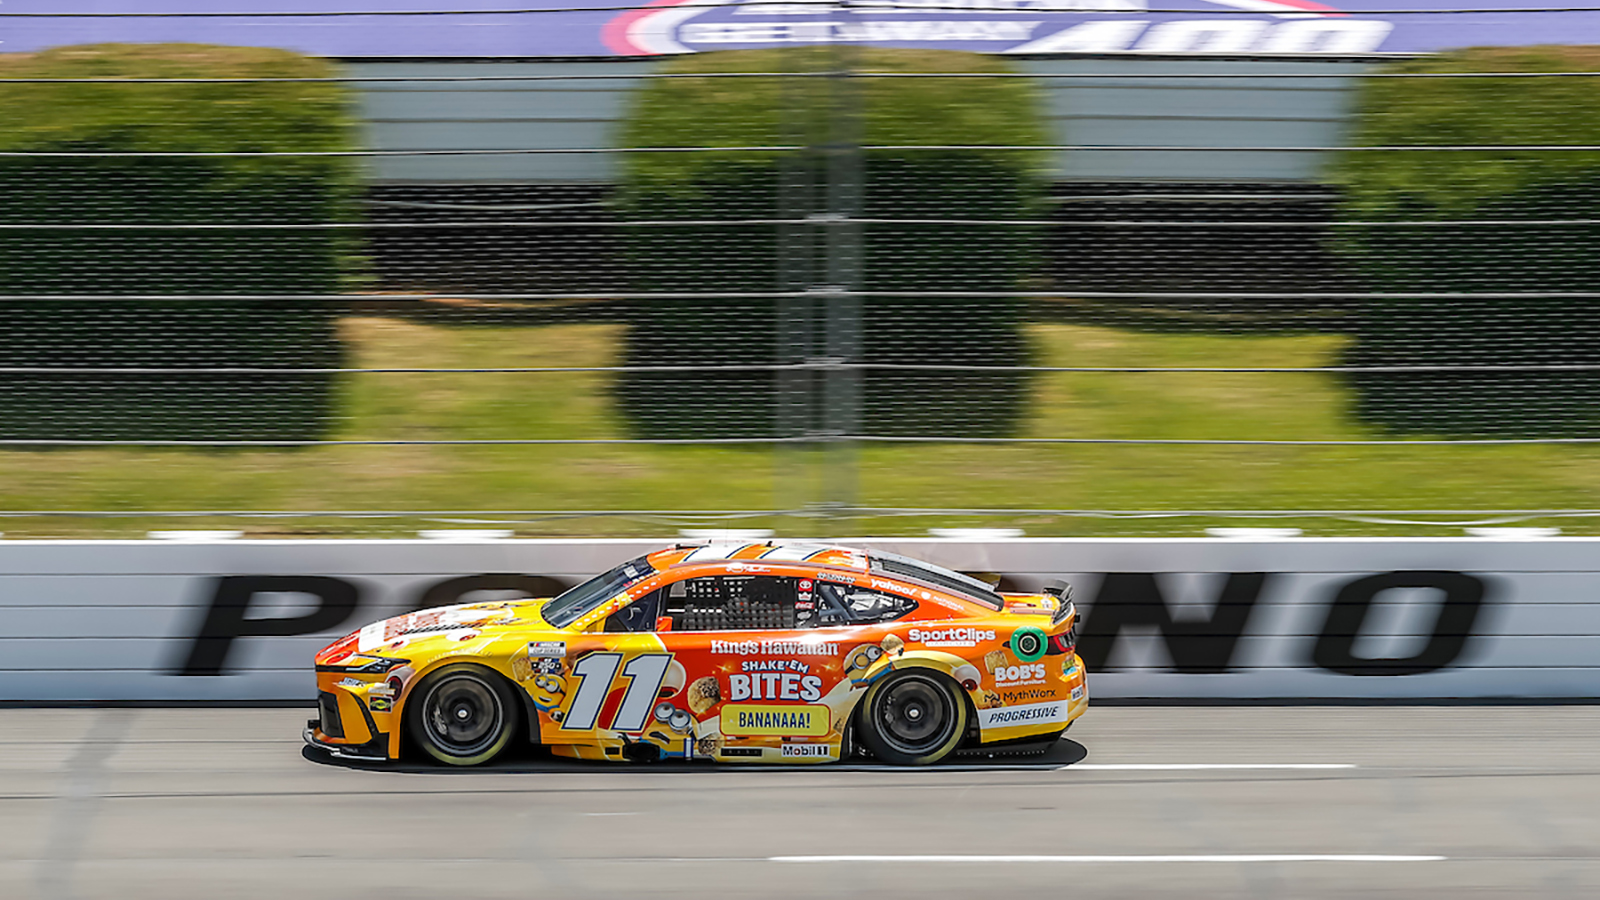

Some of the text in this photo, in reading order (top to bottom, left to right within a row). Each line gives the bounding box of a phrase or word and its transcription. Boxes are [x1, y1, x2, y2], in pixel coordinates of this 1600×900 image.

[871, 579, 917, 595] yahoo!
[908, 628, 996, 643] SportClips
[711, 640, 839, 656] King's Hawaiian
[995, 664, 1046, 681] BOB'S
[560, 652, 675, 732] 11
[729, 673, 822, 702] BITES
[1003, 689, 1056, 702] MythWorx
[739, 712, 810, 728] BANANAAA!
[989, 706, 1059, 723] PROGRESSIVE
[783, 746, 815, 756] Mobil
